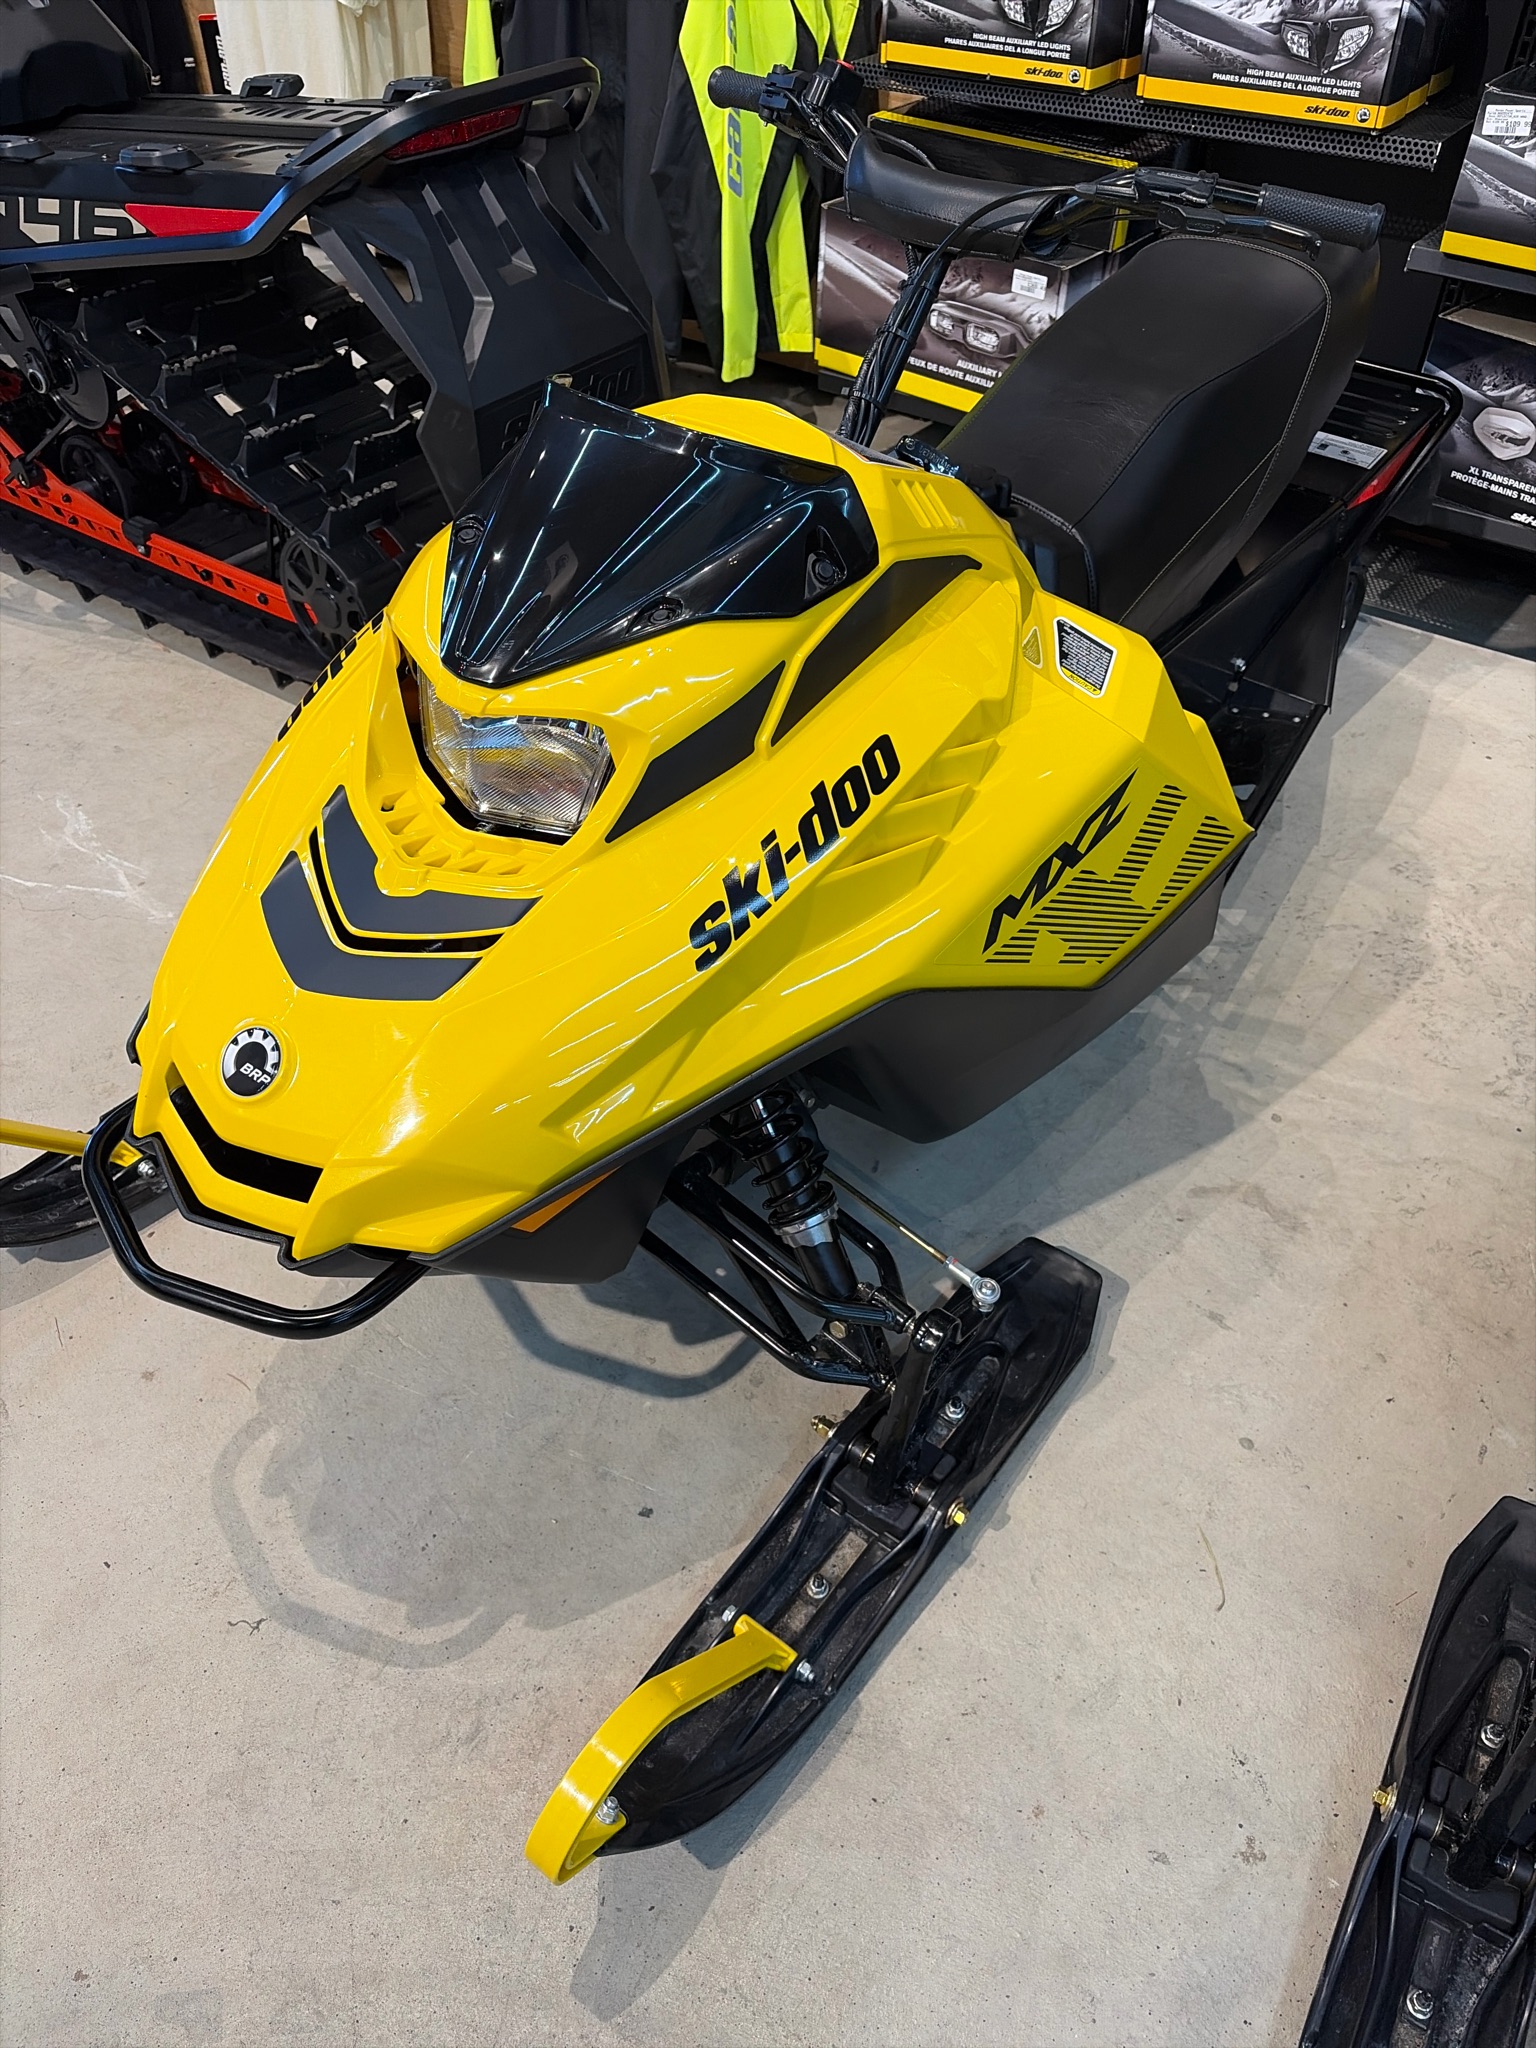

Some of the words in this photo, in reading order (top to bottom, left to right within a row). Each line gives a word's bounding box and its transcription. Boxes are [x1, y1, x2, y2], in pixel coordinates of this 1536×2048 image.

[944, 37, 968, 46] PHARES
[968, 40, 1004, 50] AUXILIAIRES
[1004, 44, 1016, 52] DEL
[1022, 47, 1046, 56] LONGUE
[1047, 50, 1070, 59] PORTÉE
[972, 32, 988, 40] HIGH
[988, 34, 1005, 42] BEAM
[1006, 36, 1037, 47] AUXILIARY
[1050, 42, 1071, 51] LIGHTS
[1024, 67, 1063, 78] ski-doo
[1246, 68, 1264, 76] HIGH
[1265, 70, 1285, 79] BEAM
[1286, 72, 1322, 84] AUXILIARY
[1322, 77, 1335, 86] LED
[1336, 79, 1361, 89] LIGHTS
[1212, 73, 1239, 82] PHARES
[1240, 76, 1282, 88] AUXILIAIRES
[1282, 81, 1297, 90] DEL
[1303, 84, 1332, 94] LONGUE
[1332, 87, 1360, 97] PORTÉE
[1304, 104, 1350, 118] ski-doo
[927, 362, 938, 372] DE
[939, 366, 964, 380] ROUTE
[956, 359, 997, 377] AUXILIARY
[1468, 466, 1480, 476] XL
[1450, 470, 1518, 499] PROTÈGE-MAINS
[689, 733, 900, 972] ski-doo
[982, 767, 1139, 955] MXZ
[240, 1062, 272, 1084] BRP
